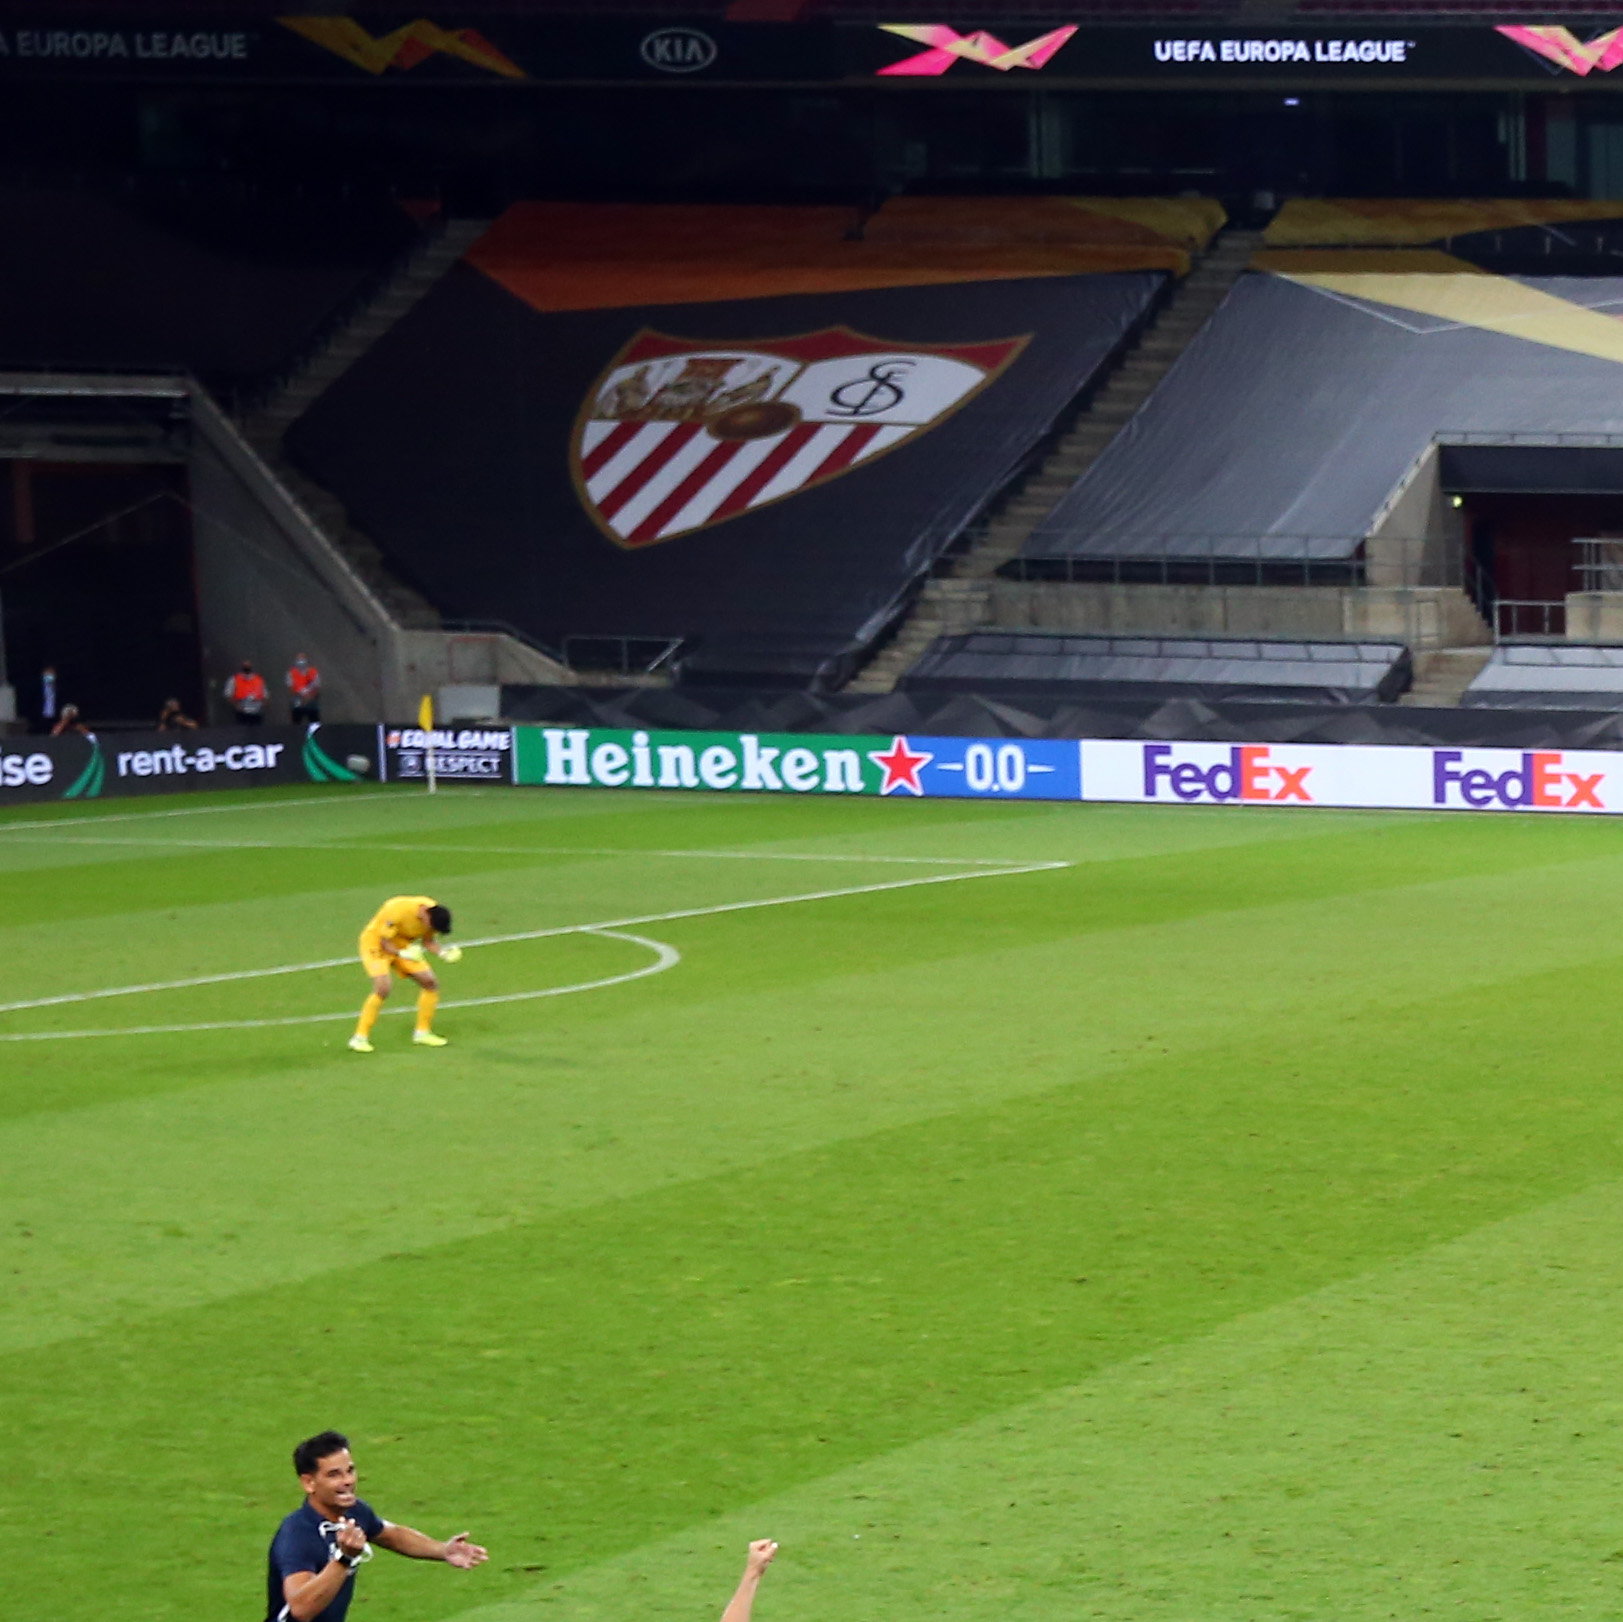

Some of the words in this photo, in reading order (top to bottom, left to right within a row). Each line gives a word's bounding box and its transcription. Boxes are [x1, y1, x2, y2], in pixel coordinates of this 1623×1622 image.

[16, 31, 129, 57] EUROPA
[136, 32, 248, 58] LEAGUE
[653, 37, 704, 62] KIA
[1154, 41, 1216, 62] UEFA
[1220, 40, 1309, 62] EUROPA
[1316, 40, 1405, 62] LEAGUE
[117, 742, 285, 778] rent-a-car
[543, 728, 864, 793] Heineken
[1143, 745, 1313, 802] FedEx
[1432, 750, 1606, 810] FedEx
